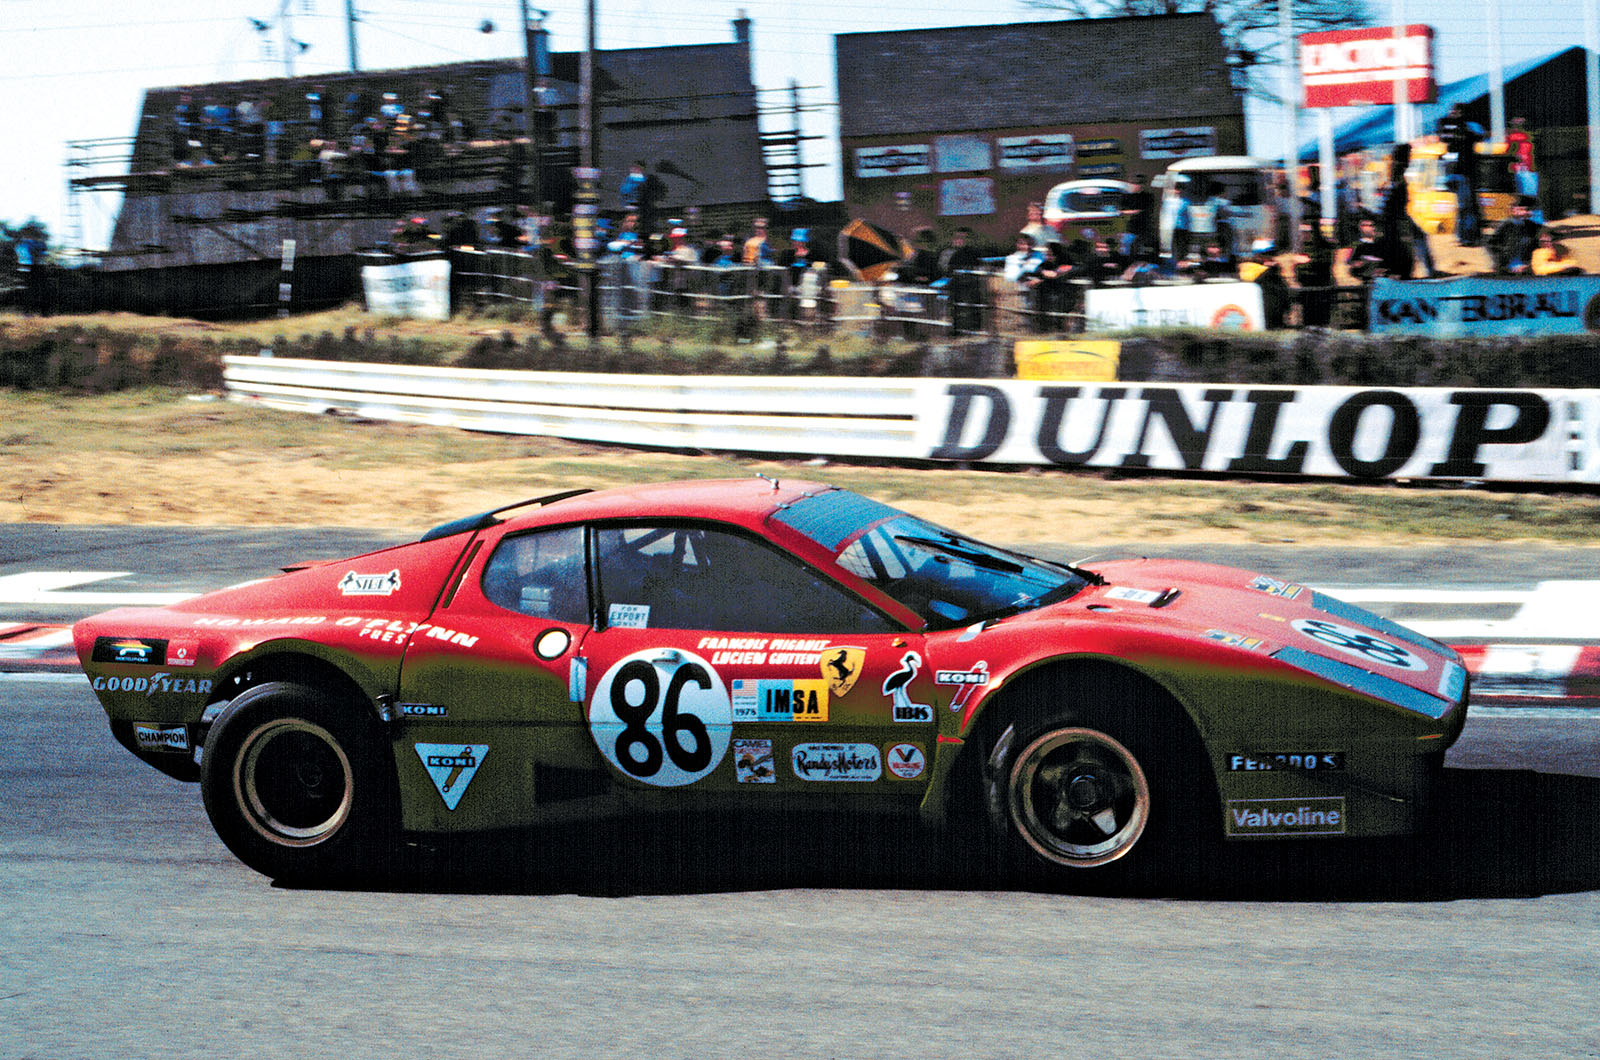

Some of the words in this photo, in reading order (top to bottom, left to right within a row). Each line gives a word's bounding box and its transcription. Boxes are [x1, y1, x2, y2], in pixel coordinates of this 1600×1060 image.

[931, 384, 1551, 477] DUNLOP
[611, 611, 646, 621] EXPORT
[335, 616, 480, 648] O'FLYNN
[711, 651, 767, 664] LUCIEN
[939, 673, 985, 683] KONI
[766, 689, 819, 714] IMSA
[402, 706, 445, 714] KONI
[896, 707, 929, 720] IBIS
[610, 660, 713, 777] 86
[138, 732, 185, 743] CHAMPION
[430, 757, 473, 766] KONI
[1231, 755, 1317, 770] FEODO
[1232, 807, 1340, 827] Valvoline
